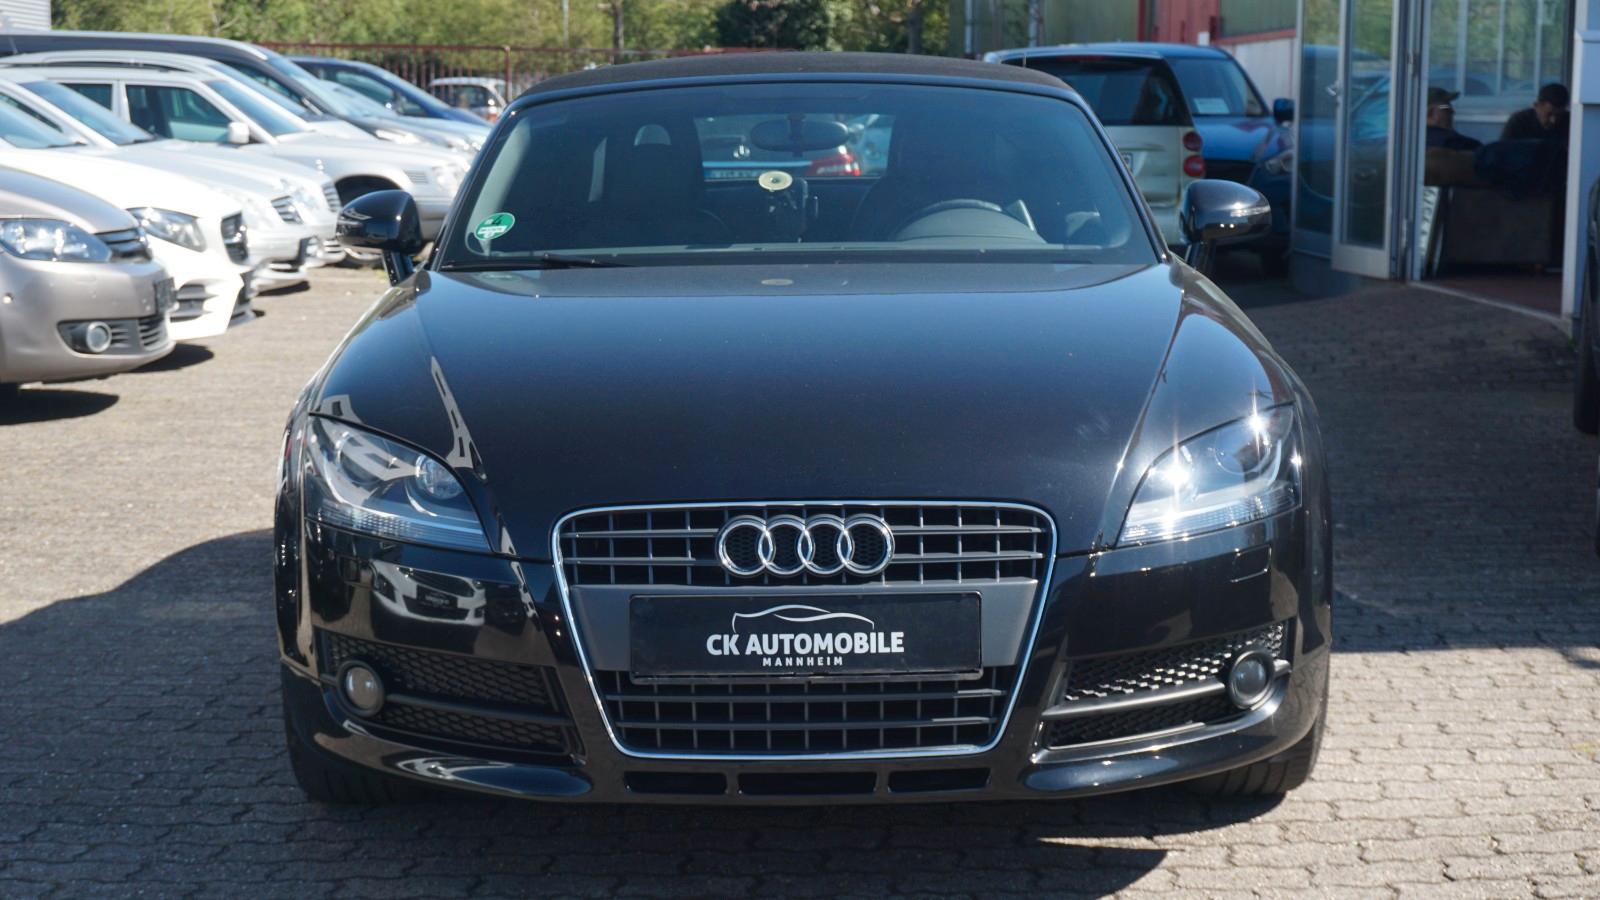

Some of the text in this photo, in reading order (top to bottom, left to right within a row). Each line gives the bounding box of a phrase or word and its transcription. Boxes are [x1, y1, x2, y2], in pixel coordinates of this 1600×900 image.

[491, 214, 503, 226] 4
[706, 631, 905, 656] CK AUTOMOBILE
[762, 656, 844, 667] MANNHEIM
